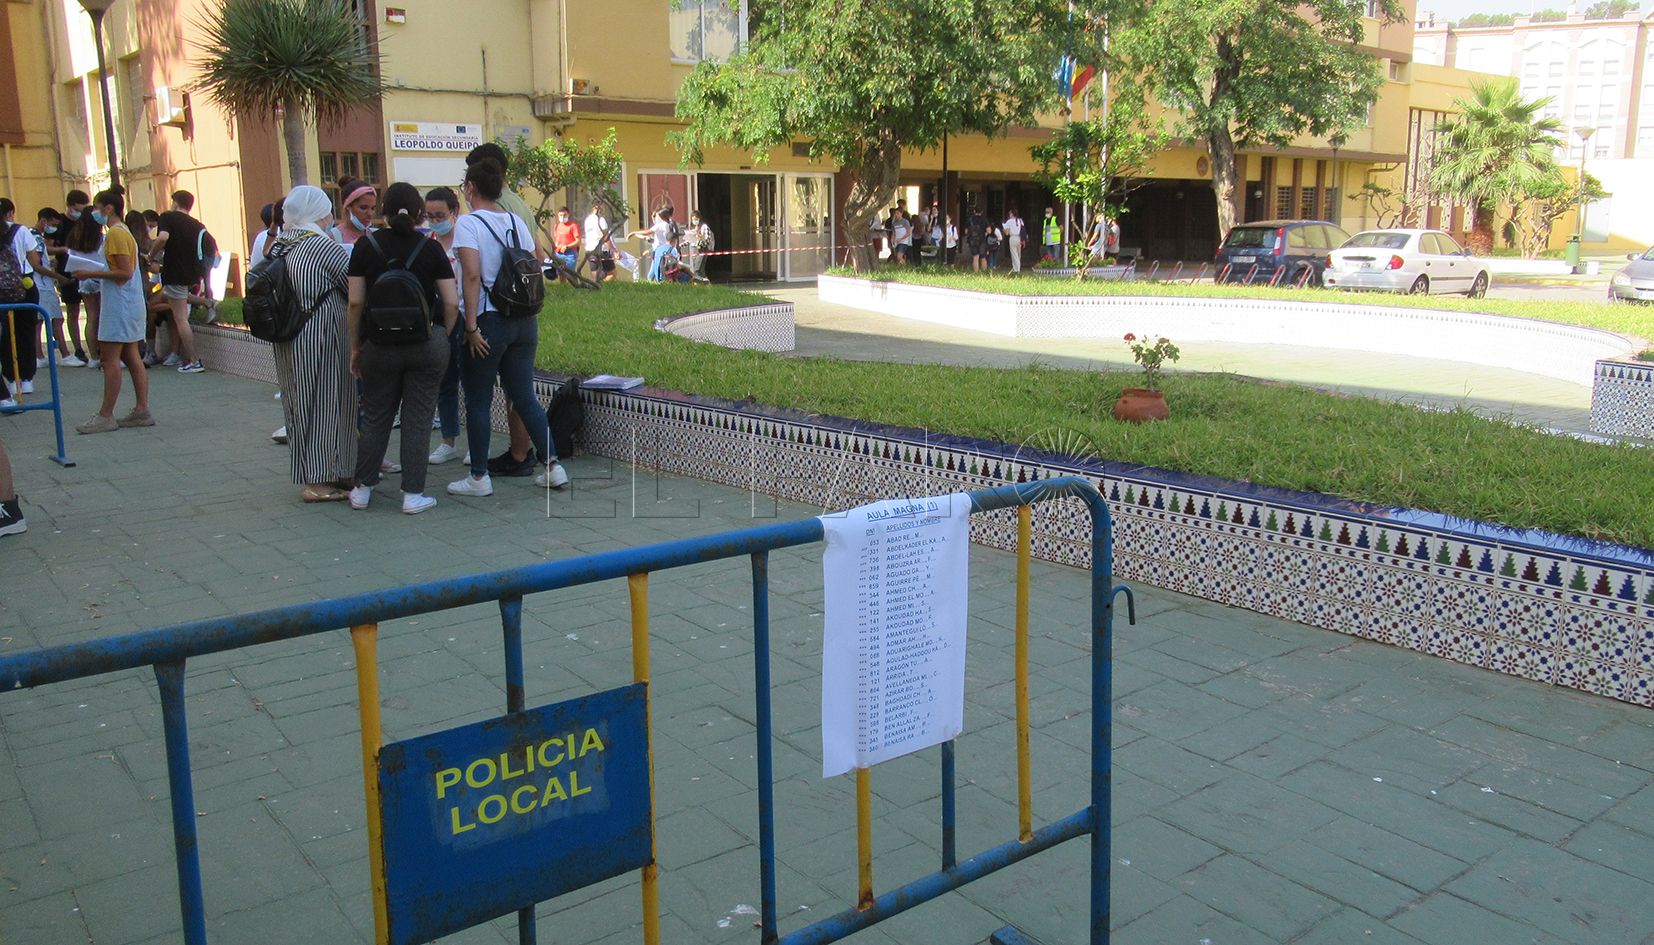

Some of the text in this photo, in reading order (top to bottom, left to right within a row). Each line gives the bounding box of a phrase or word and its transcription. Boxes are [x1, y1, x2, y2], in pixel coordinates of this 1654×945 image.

[394, 140, 479, 149] LEOPOLDO QUEIPO
[867, 510, 889, 520] AULA
[893, 504, 924, 516] MAGNA
[887, 536, 902, 544] ABAD
[887, 541, 922, 553] ABDELKADER
[886, 569, 910, 579] AGUADO
[886, 587, 906, 596] AHMED
[887, 596, 906, 605] AHMED
[887, 604, 906, 613] AHMED
[435, 728, 605, 799] POLICIA
[451, 771, 592, 835] LOCAL
